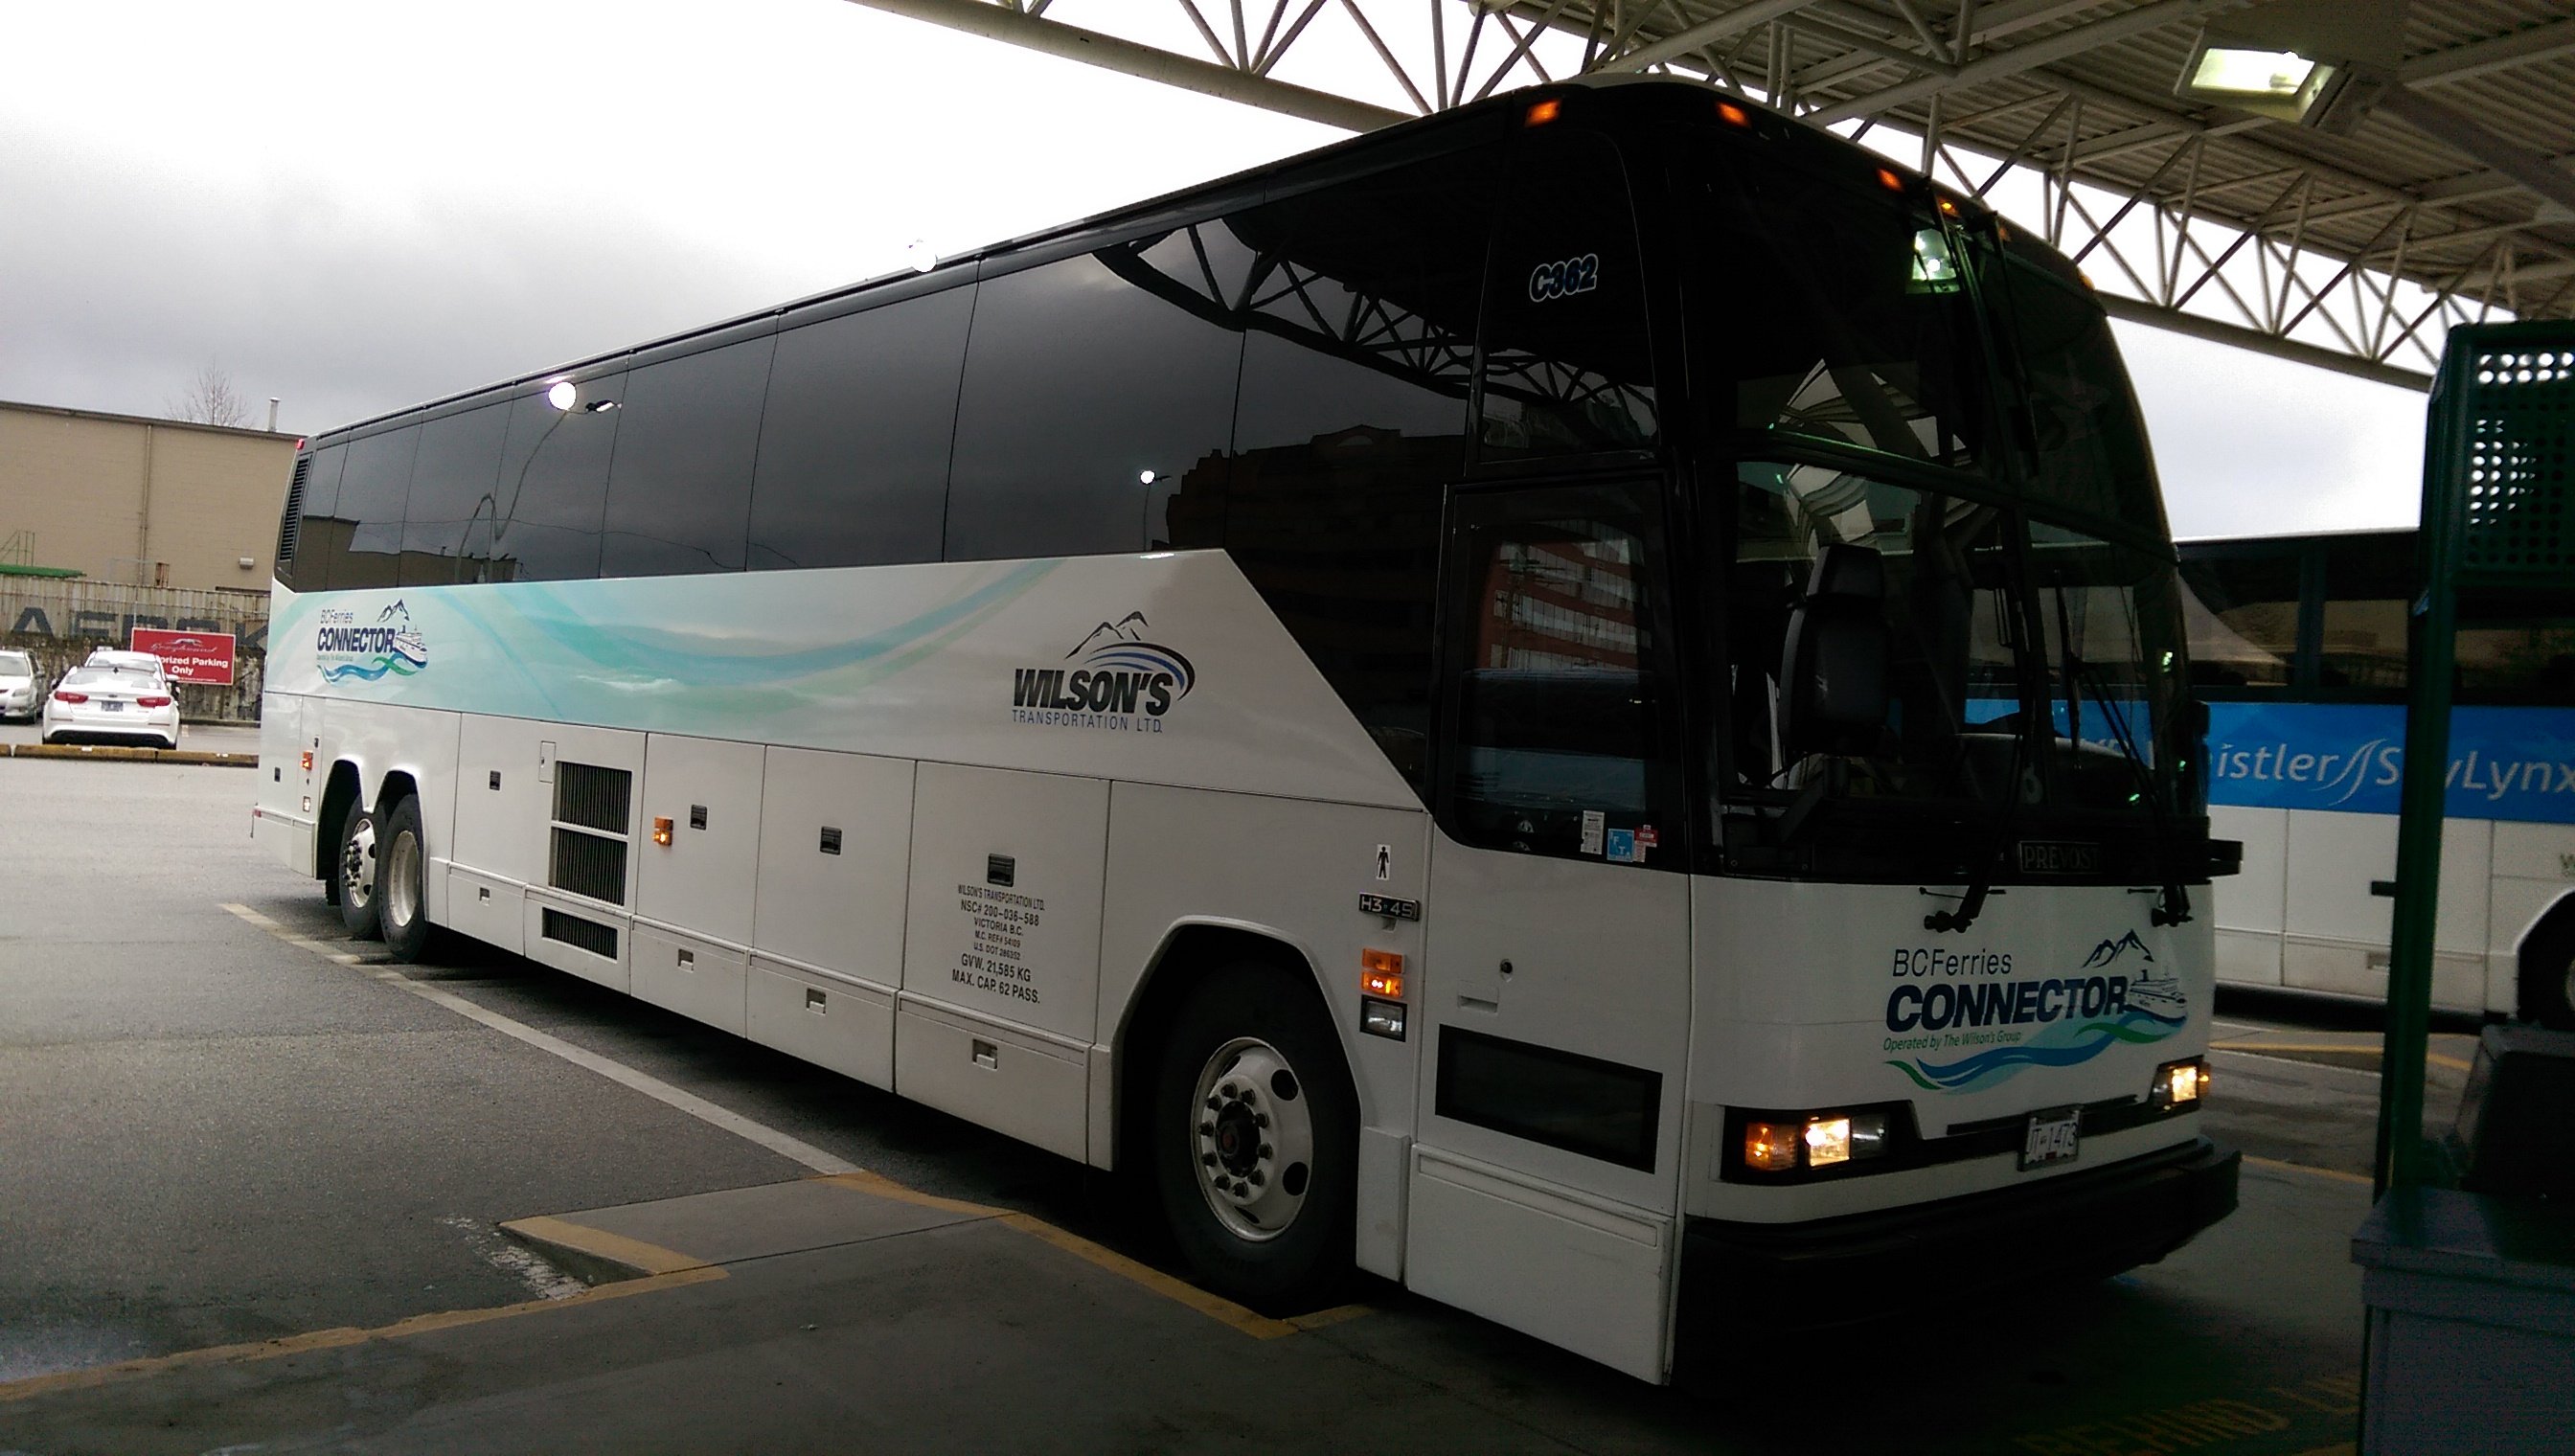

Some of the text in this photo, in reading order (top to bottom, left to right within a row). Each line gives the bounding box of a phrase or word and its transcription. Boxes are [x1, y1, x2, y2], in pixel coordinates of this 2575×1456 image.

[1529, 253, 1599, 303] C362
[317, 627, 396, 652] CONNECTOR
[171, 666, 194, 675] Only
[193, 657, 229, 668] Parking
[1014, 669, 1174, 717] WILSON'S
[1012, 709, 1163, 733] TRANSPORTATION LTD.
[2023, 845, 2100, 870] PREVOST
[958, 884, 1045, 911] WILSON'S TRANSPORTATION LTD.
[961, 899, 1039, 926] NSC# 200-036-588
[974, 917, 1024, 936] VICTORIA B.C.
[973, 942, 984, 952] U.S.
[986, 944, 999, 956] DOT
[961, 953, 1031, 982] GVW. 21,585 KG
[1892, 948, 2012, 977] BCFerries
[952, 968, 1040, 1004] MAX. CAP. 62 PASS.
[1886, 975, 2129, 1034] CONNECTOR
[1883, 1031, 2022, 1052] Operated by The Wilson's Group
